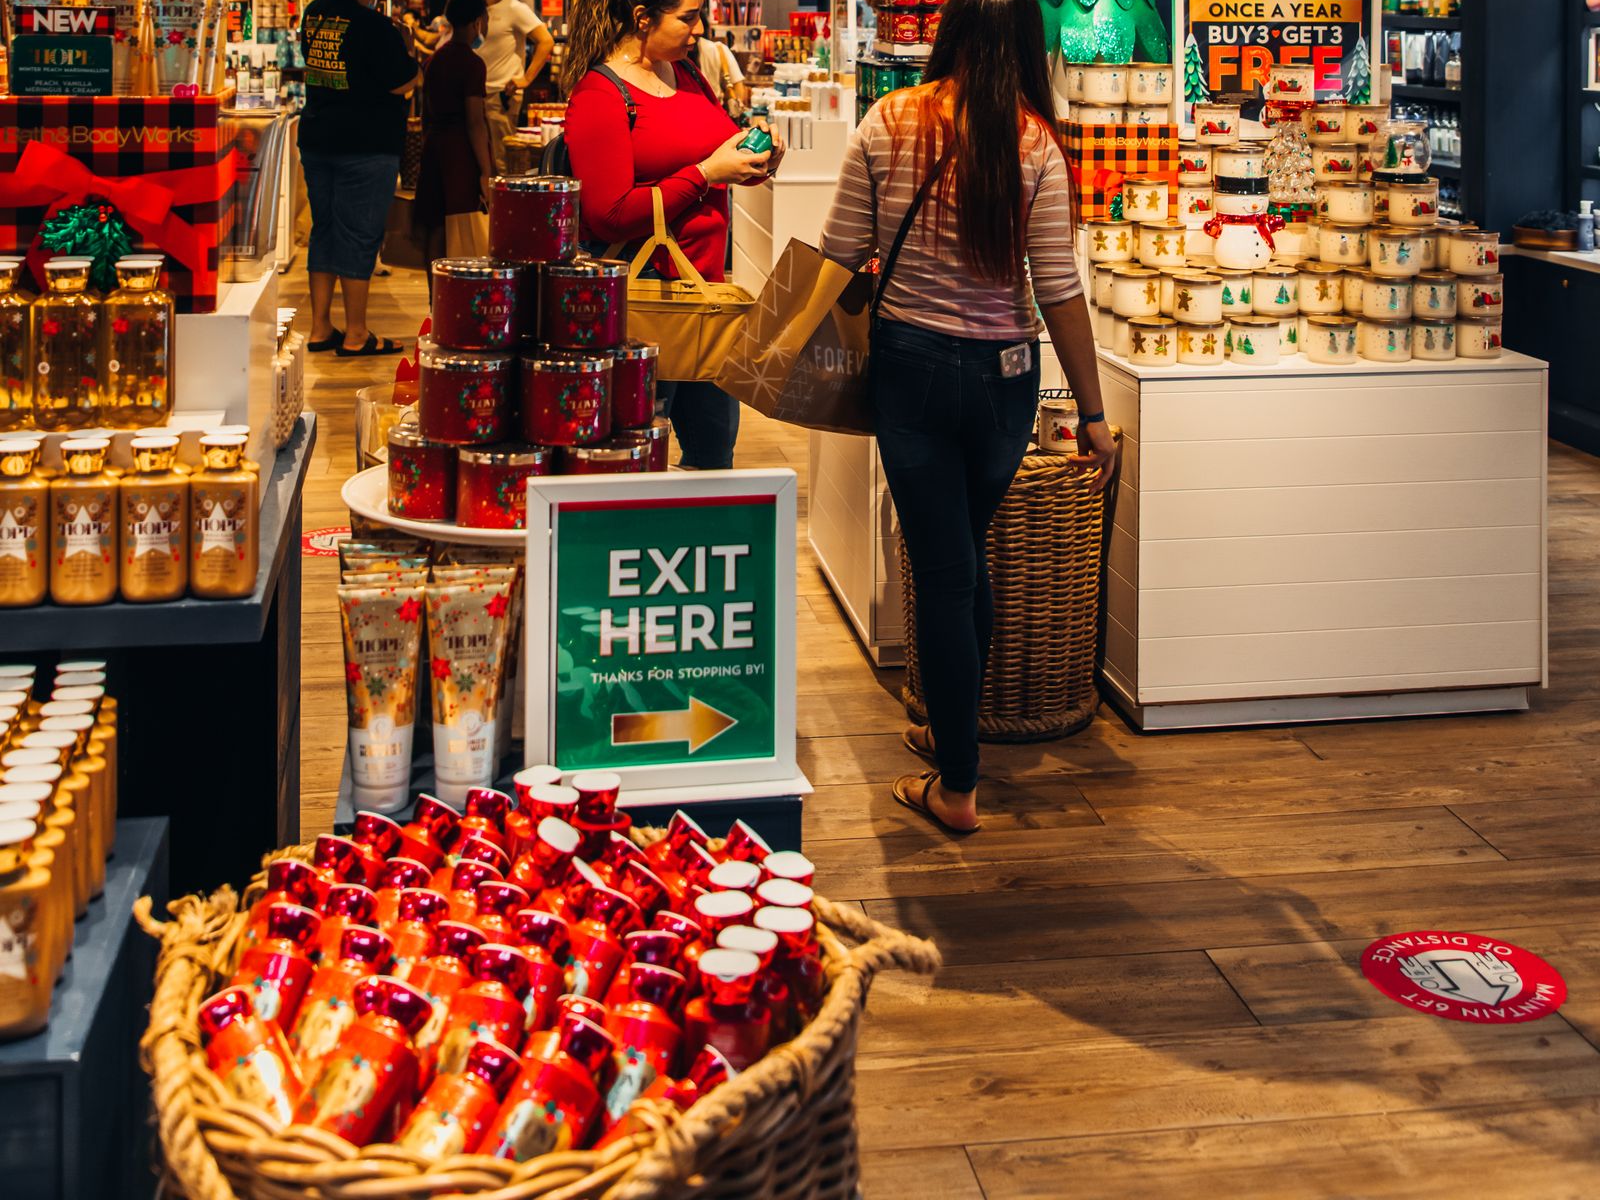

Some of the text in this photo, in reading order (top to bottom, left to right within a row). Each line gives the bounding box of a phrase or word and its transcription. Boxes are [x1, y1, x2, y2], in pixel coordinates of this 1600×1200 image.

[1208, 3, 1342, 18] ONCE A YEAR
[33, 10, 98, 33] NEW
[306, 30, 342, 41] CTURE,
[1208, 25, 1255, 44] BUY
[1282, 25, 1328, 44] GET
[31, 48, 93, 65] HOPE
[324, 50, 339, 60] MY
[3, 126, 57, 142] Bath
[72, 125, 131, 147] Body
[132, 125, 203, 142] Works
[0, 526, 33, 540] OPE
[59, 522, 110, 537] HOPE
[129, 521, 180, 536] HOPE
[608, 544, 750, 597] EXIT
[600, 601, 754, 657] HERE
[355, 638, 404, 653] HOPE
[445, 634, 493, 649] HOPE
[590, 664, 765, 684] THANKS FOR STOPPING BY!
[1372, 935, 1512, 963] OF DISTANCE
[1401, 982, 1555, 1019] MAINTAIN 6FT
